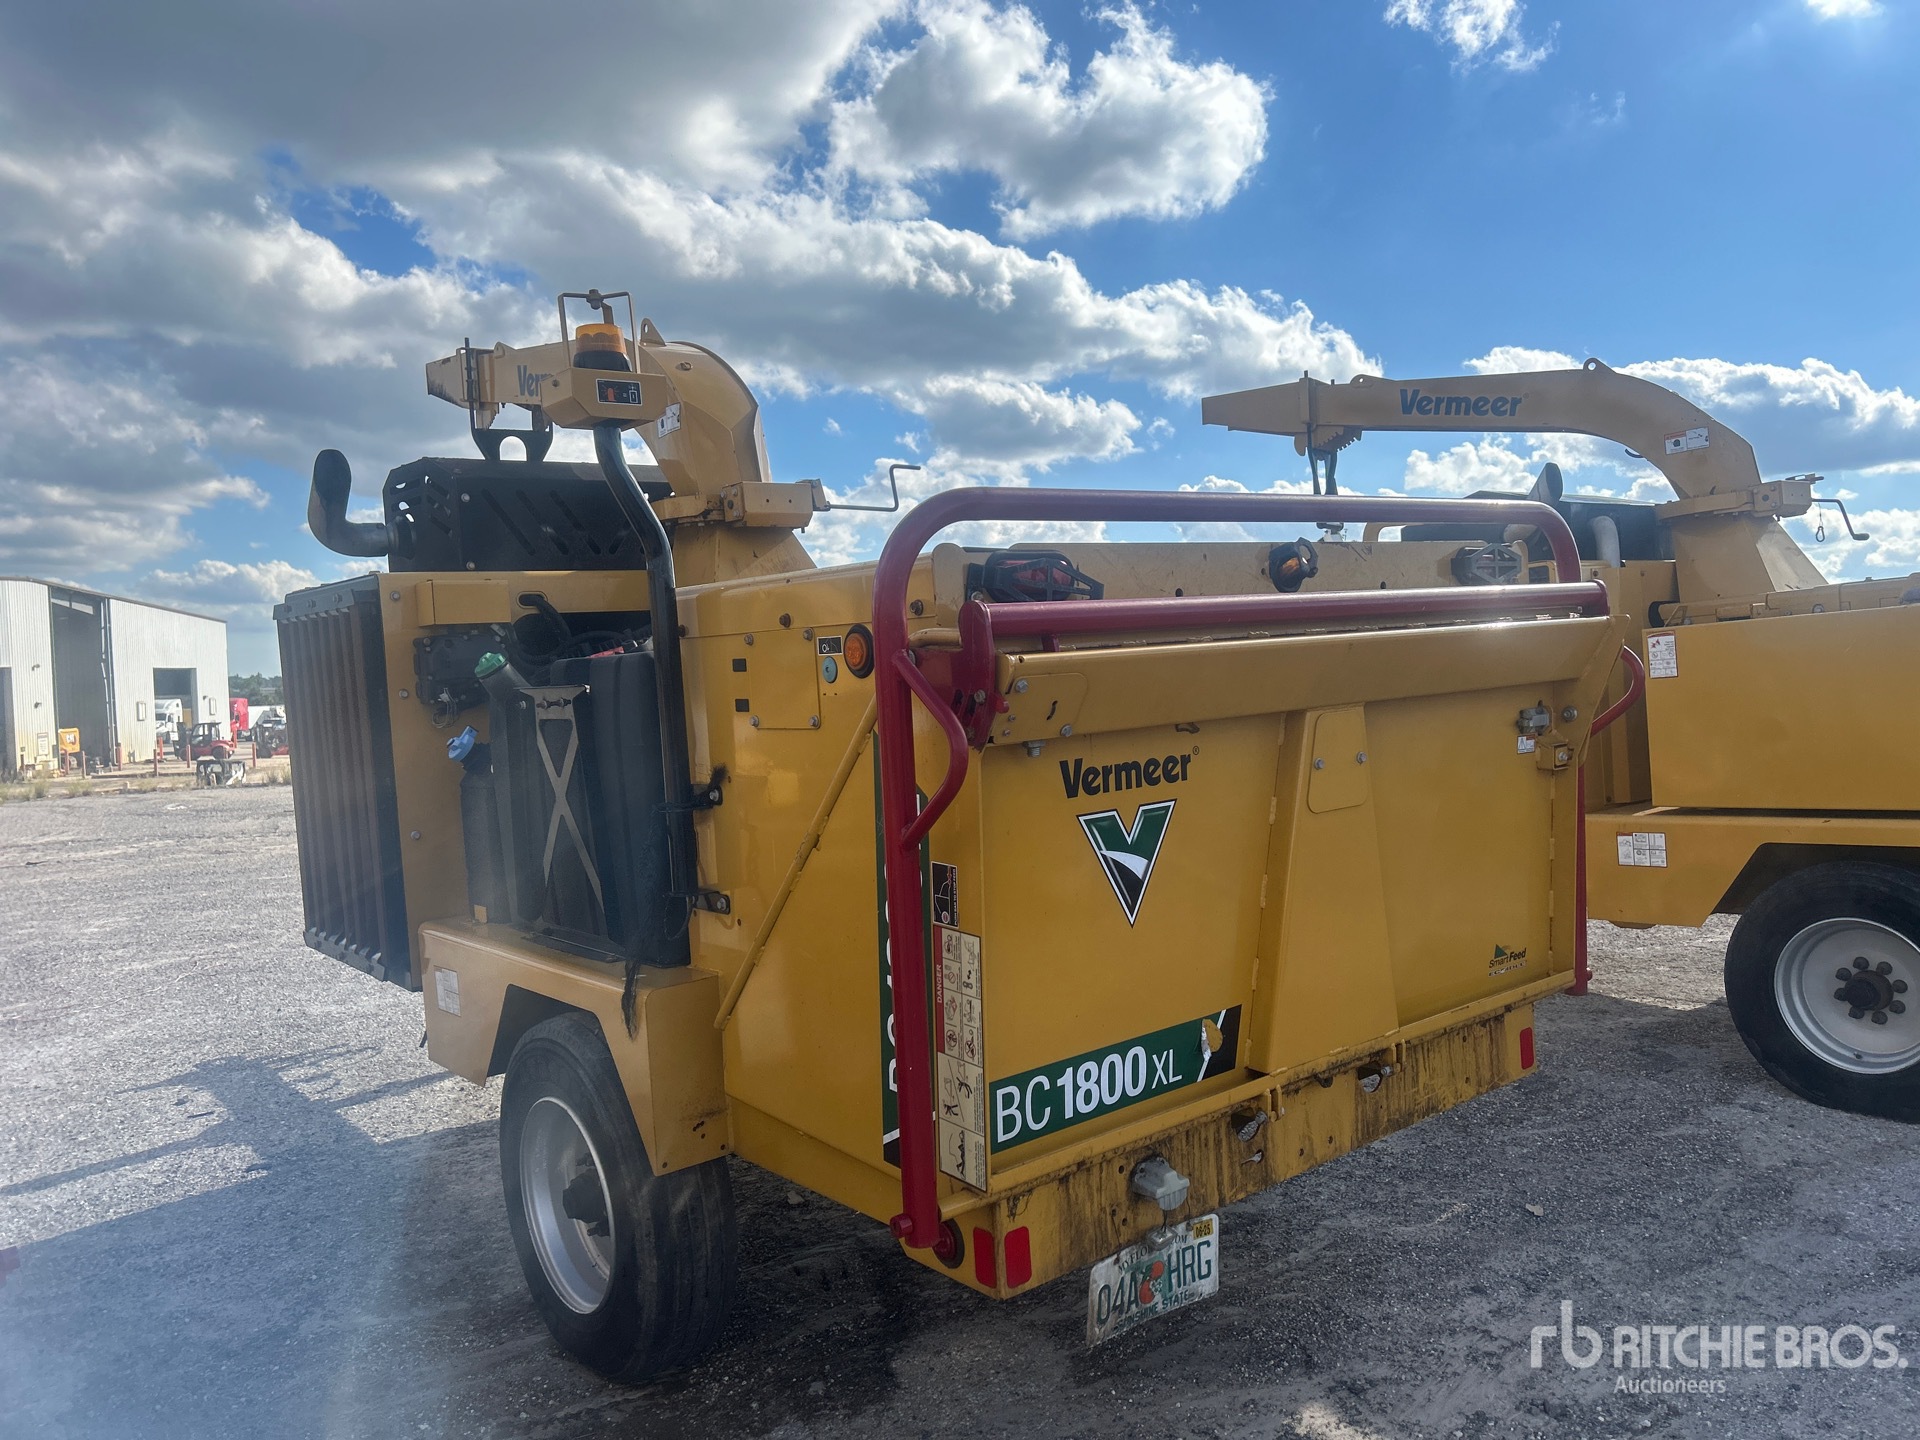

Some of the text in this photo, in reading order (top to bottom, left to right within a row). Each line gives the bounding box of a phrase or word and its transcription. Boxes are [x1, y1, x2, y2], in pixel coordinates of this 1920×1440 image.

[1400, 388, 1523, 417] Vermeer
[1059, 754, 1191, 799] Vermeer
[1167, 1240, 1212, 1293] HRG
[1162, 1290, 1189, 1311] STATE
